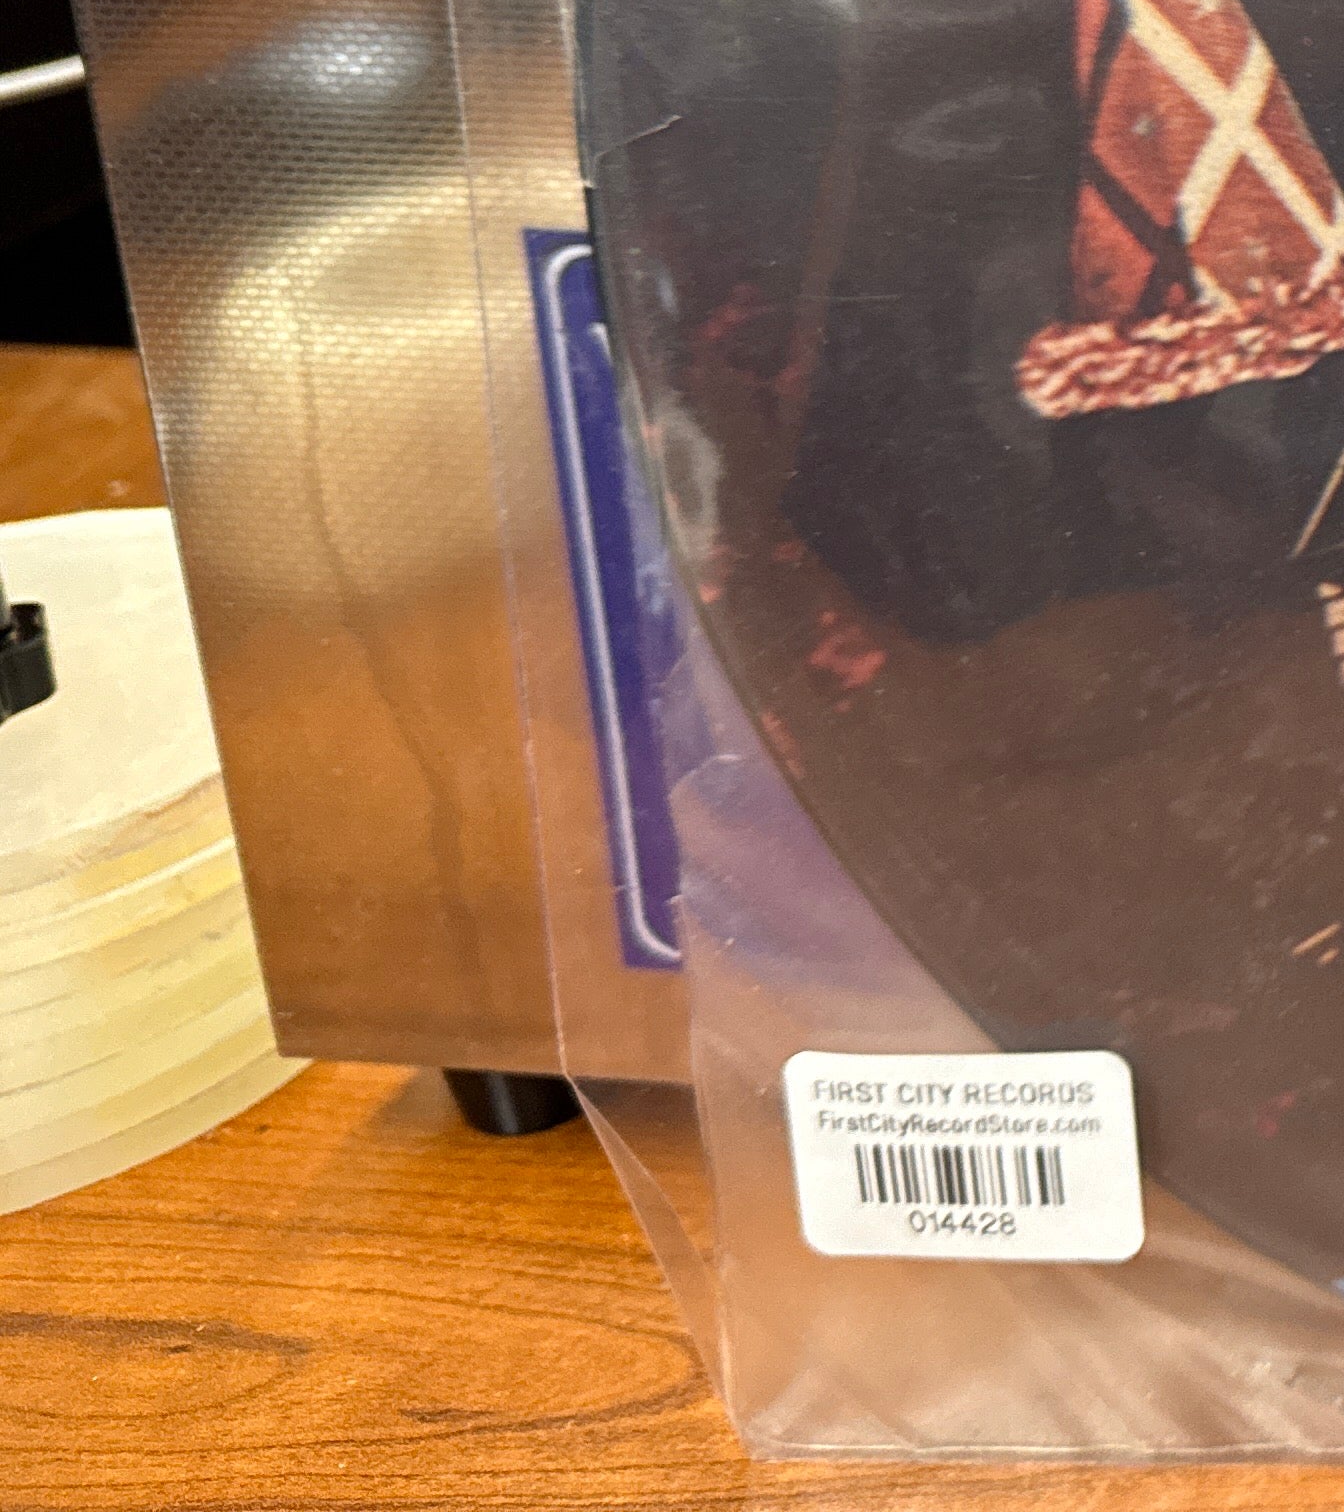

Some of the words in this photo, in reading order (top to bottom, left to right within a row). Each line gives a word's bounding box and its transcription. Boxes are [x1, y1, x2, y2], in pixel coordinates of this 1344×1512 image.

[812, 1079, 888, 1105] FIRST
[896, 1080, 955, 1105] CITY
[963, 1081, 1096, 1106] RECORDS
[817, 1109, 1102, 1138] FirstCityRecordStore.com
[908, 1211, 1018, 1237] 014428
